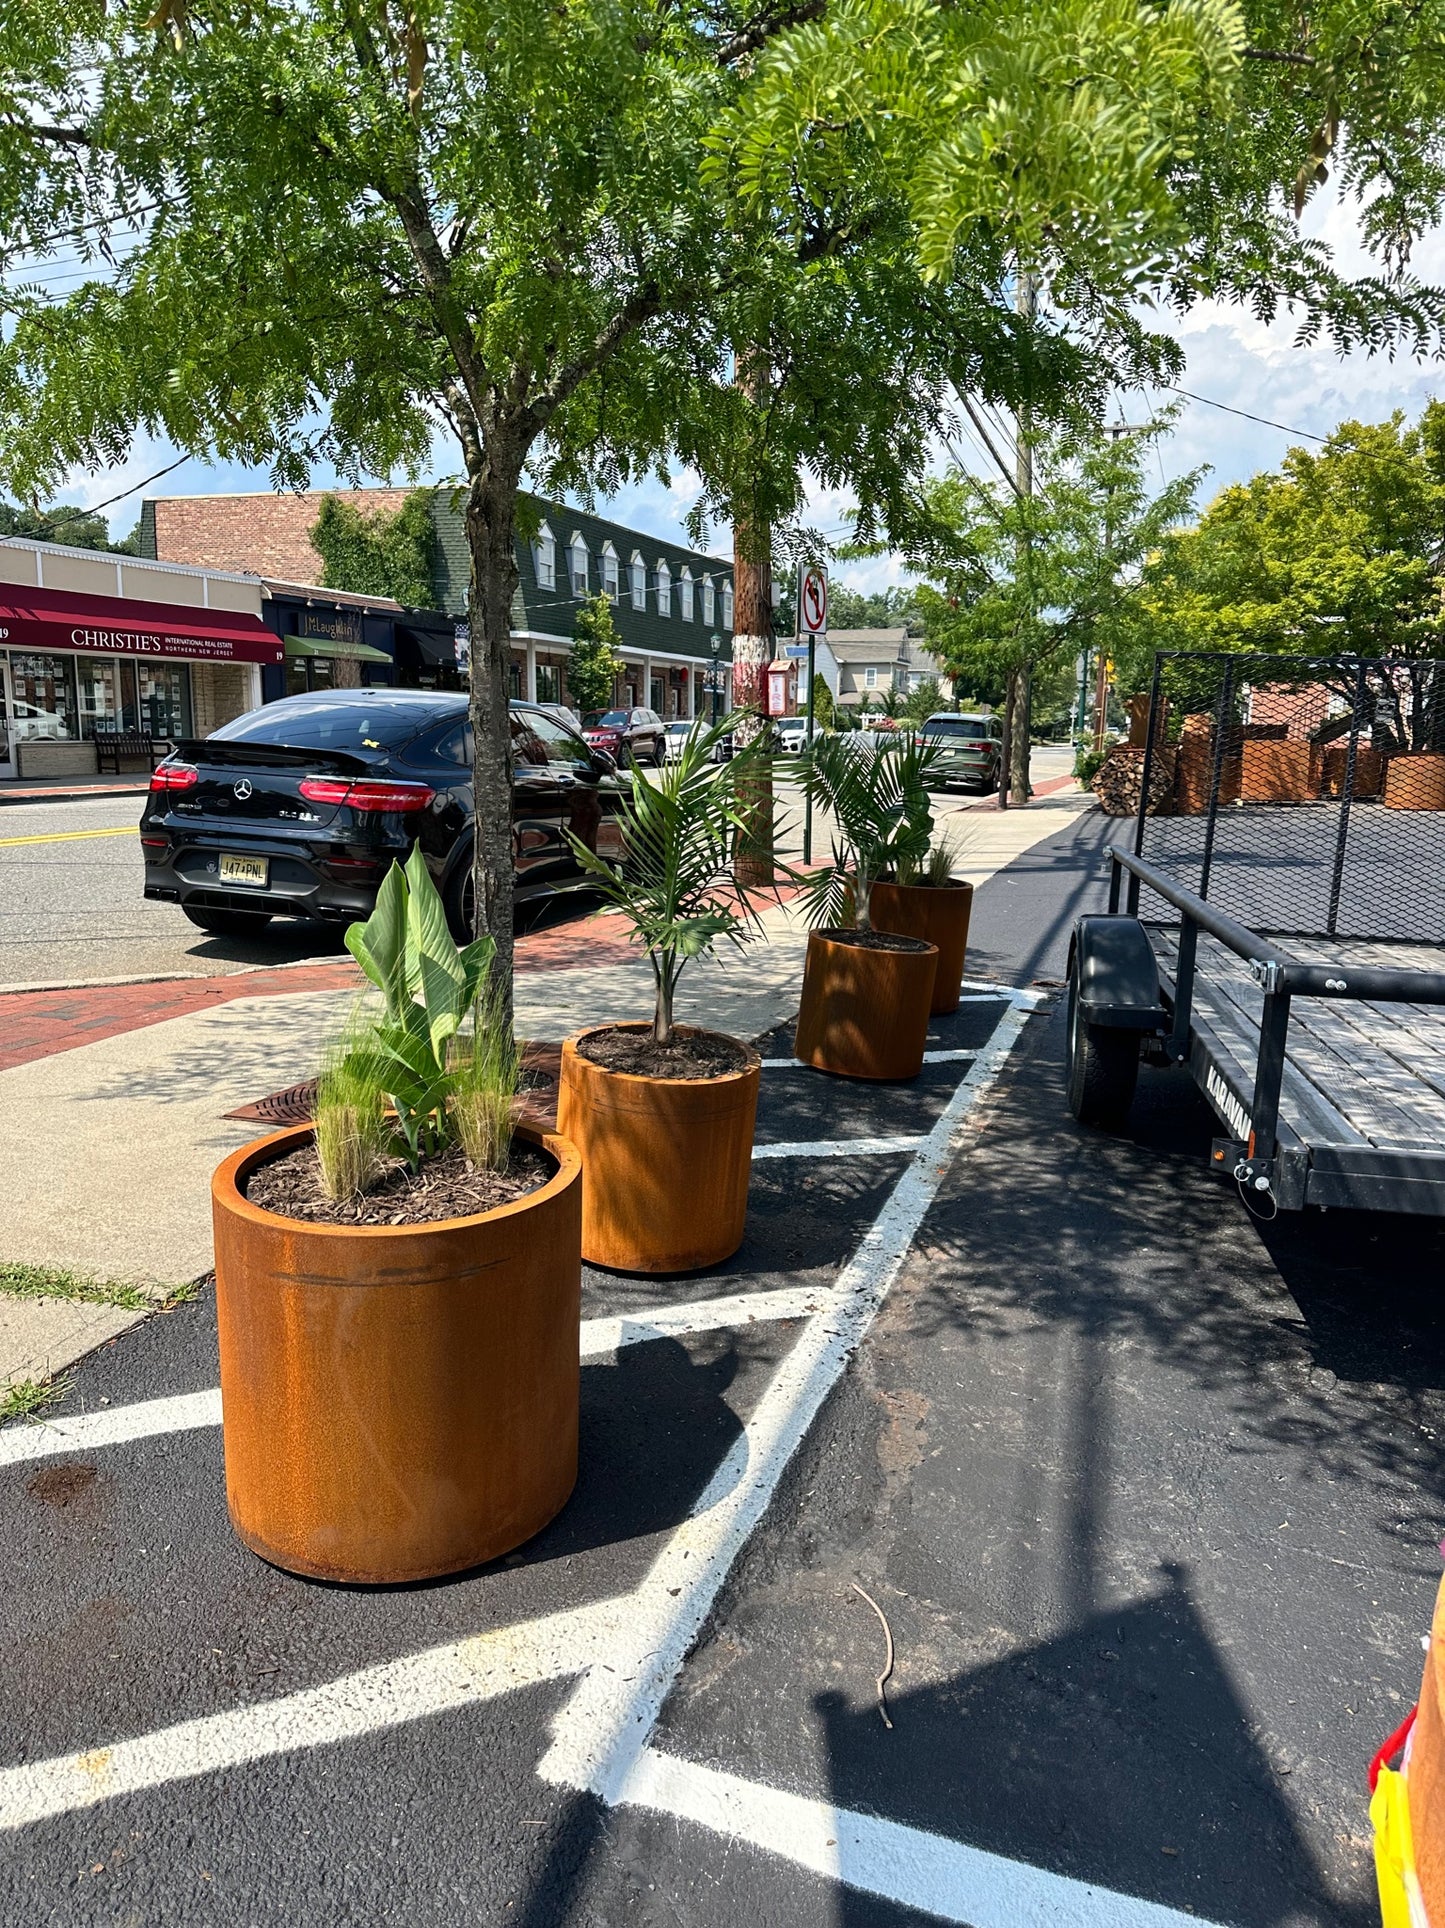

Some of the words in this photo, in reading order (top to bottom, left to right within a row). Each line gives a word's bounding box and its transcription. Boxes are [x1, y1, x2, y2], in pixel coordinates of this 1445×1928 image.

[71, 628, 161, 652] CHRISTIE'S
[165, 637, 204, 647] INTERNATIONAL
[204, 640, 216, 648] REAL
[217, 641, 233, 649] ESTATE
[165, 645, 197, 654] NORTHERN
[276, 651, 283, 661] 19
[772, 675, 781, 710] FIRE
[1206, 1065, 1252, 1142] KARAVAN
